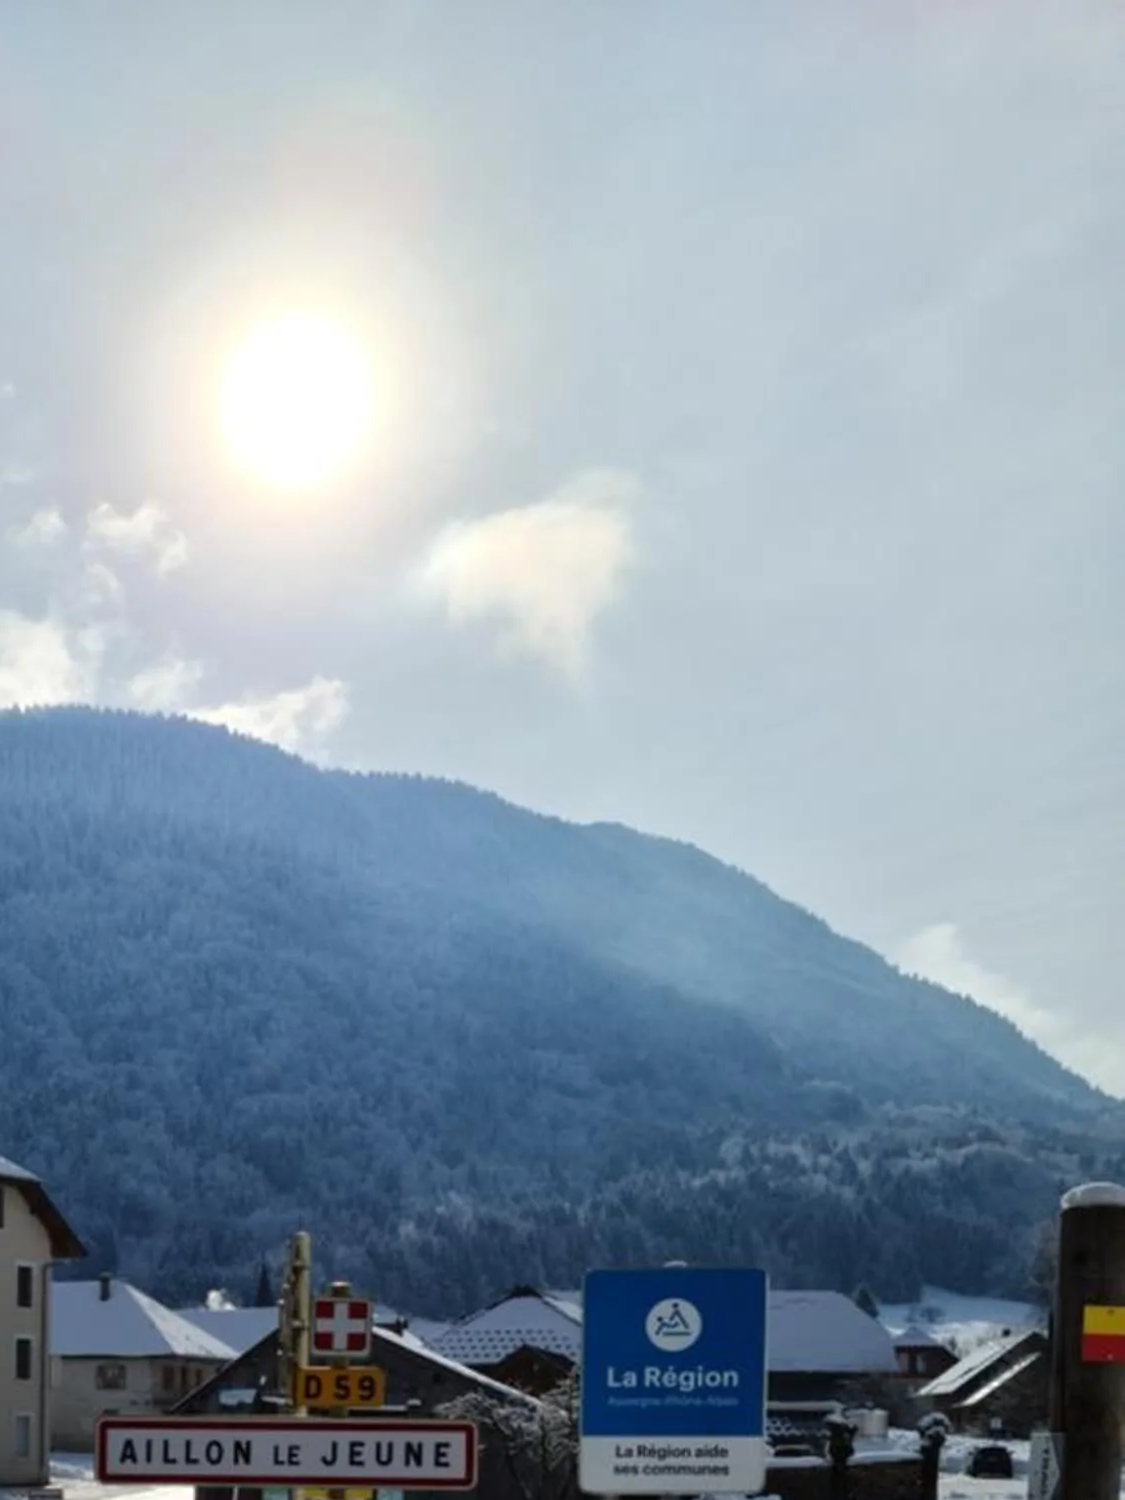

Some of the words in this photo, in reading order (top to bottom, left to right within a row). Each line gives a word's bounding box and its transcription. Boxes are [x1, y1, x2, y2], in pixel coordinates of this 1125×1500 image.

[304, 1374, 322, 1399] D
[332, 1375, 376, 1400] 59
[606, 1366, 637, 1388] La
[643, 1365, 739, 1393] Région
[118, 1438, 253, 1466] AILLON
[273, 1444, 302, 1467] LE
[320, 1440, 452, 1469] JEUNE
[615, 1445, 633, 1459] La
[636, 1444, 692, 1461] Région
[694, 1445, 729, 1459] aide
[613, 1464, 639, 1476] ses
[641, 1464, 731, 1477] communes
